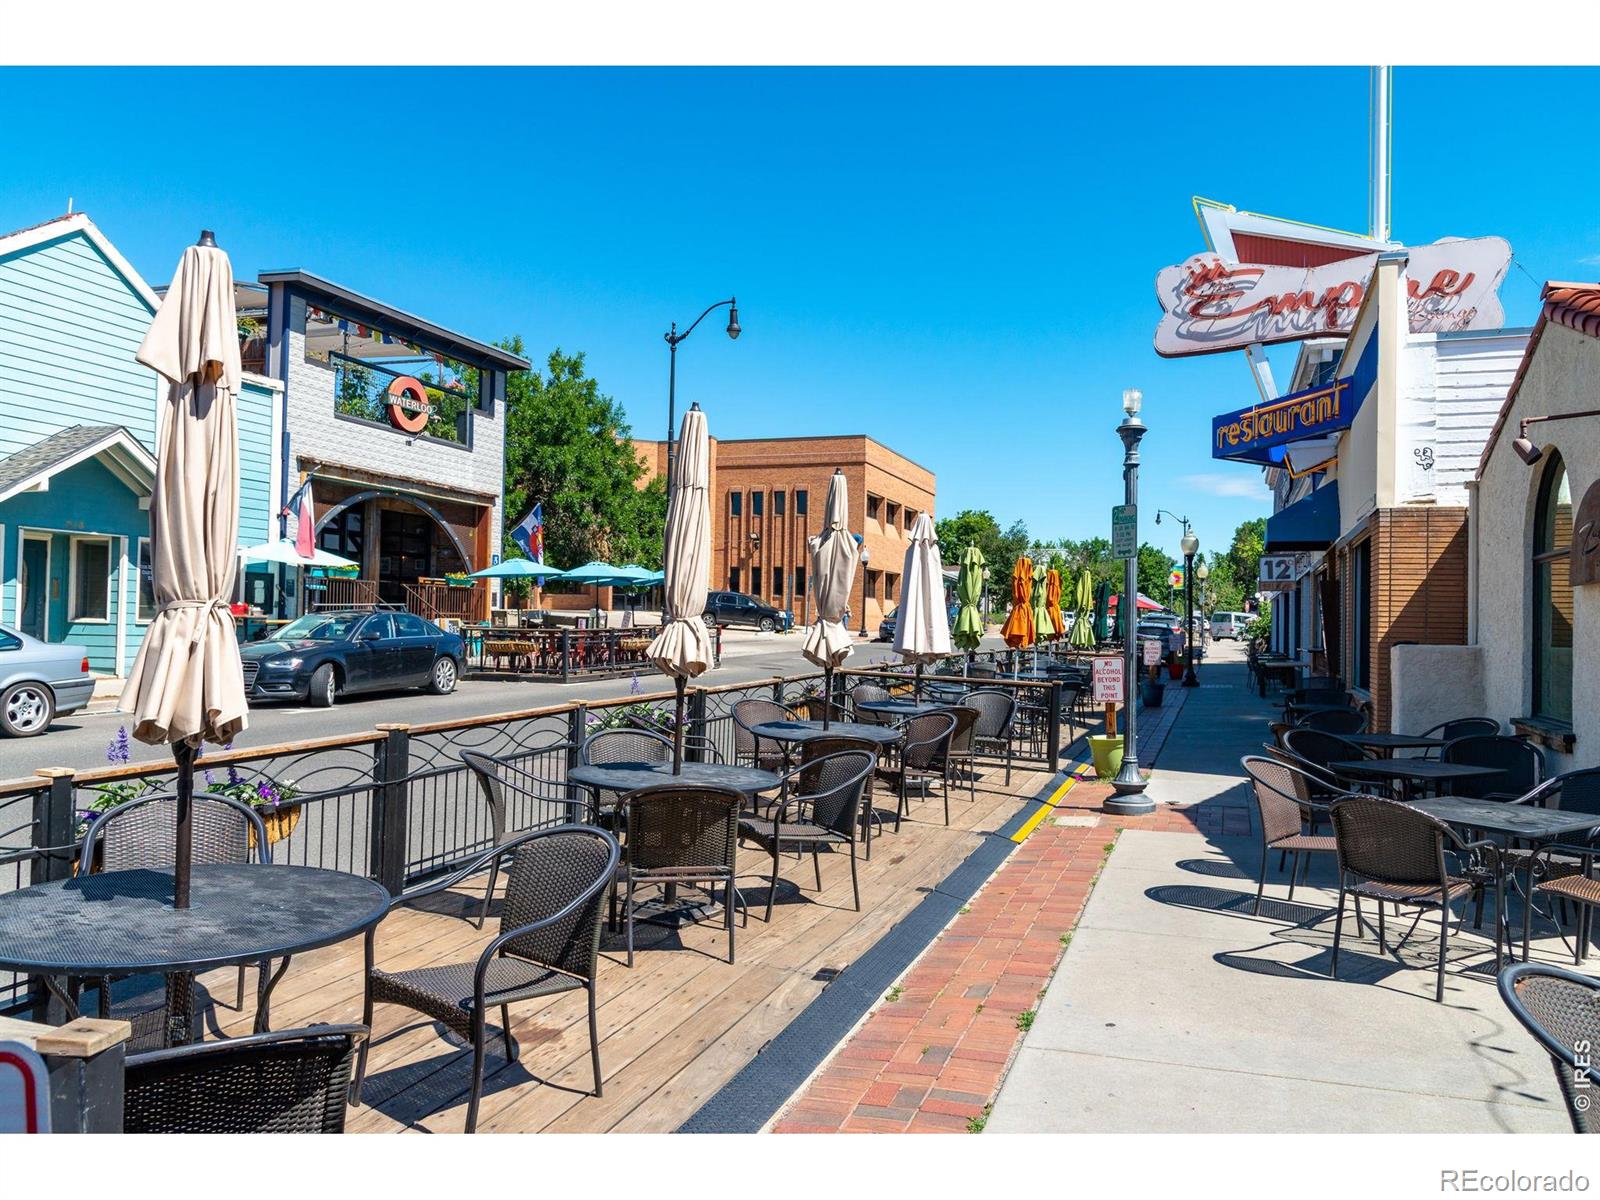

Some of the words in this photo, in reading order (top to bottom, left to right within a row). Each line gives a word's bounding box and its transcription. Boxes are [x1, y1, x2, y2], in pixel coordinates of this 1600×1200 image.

[1184, 263, 1475, 329] Empe
[388, 394, 433, 414] WATERLOO
[1216, 380, 1349, 449] restaurant
